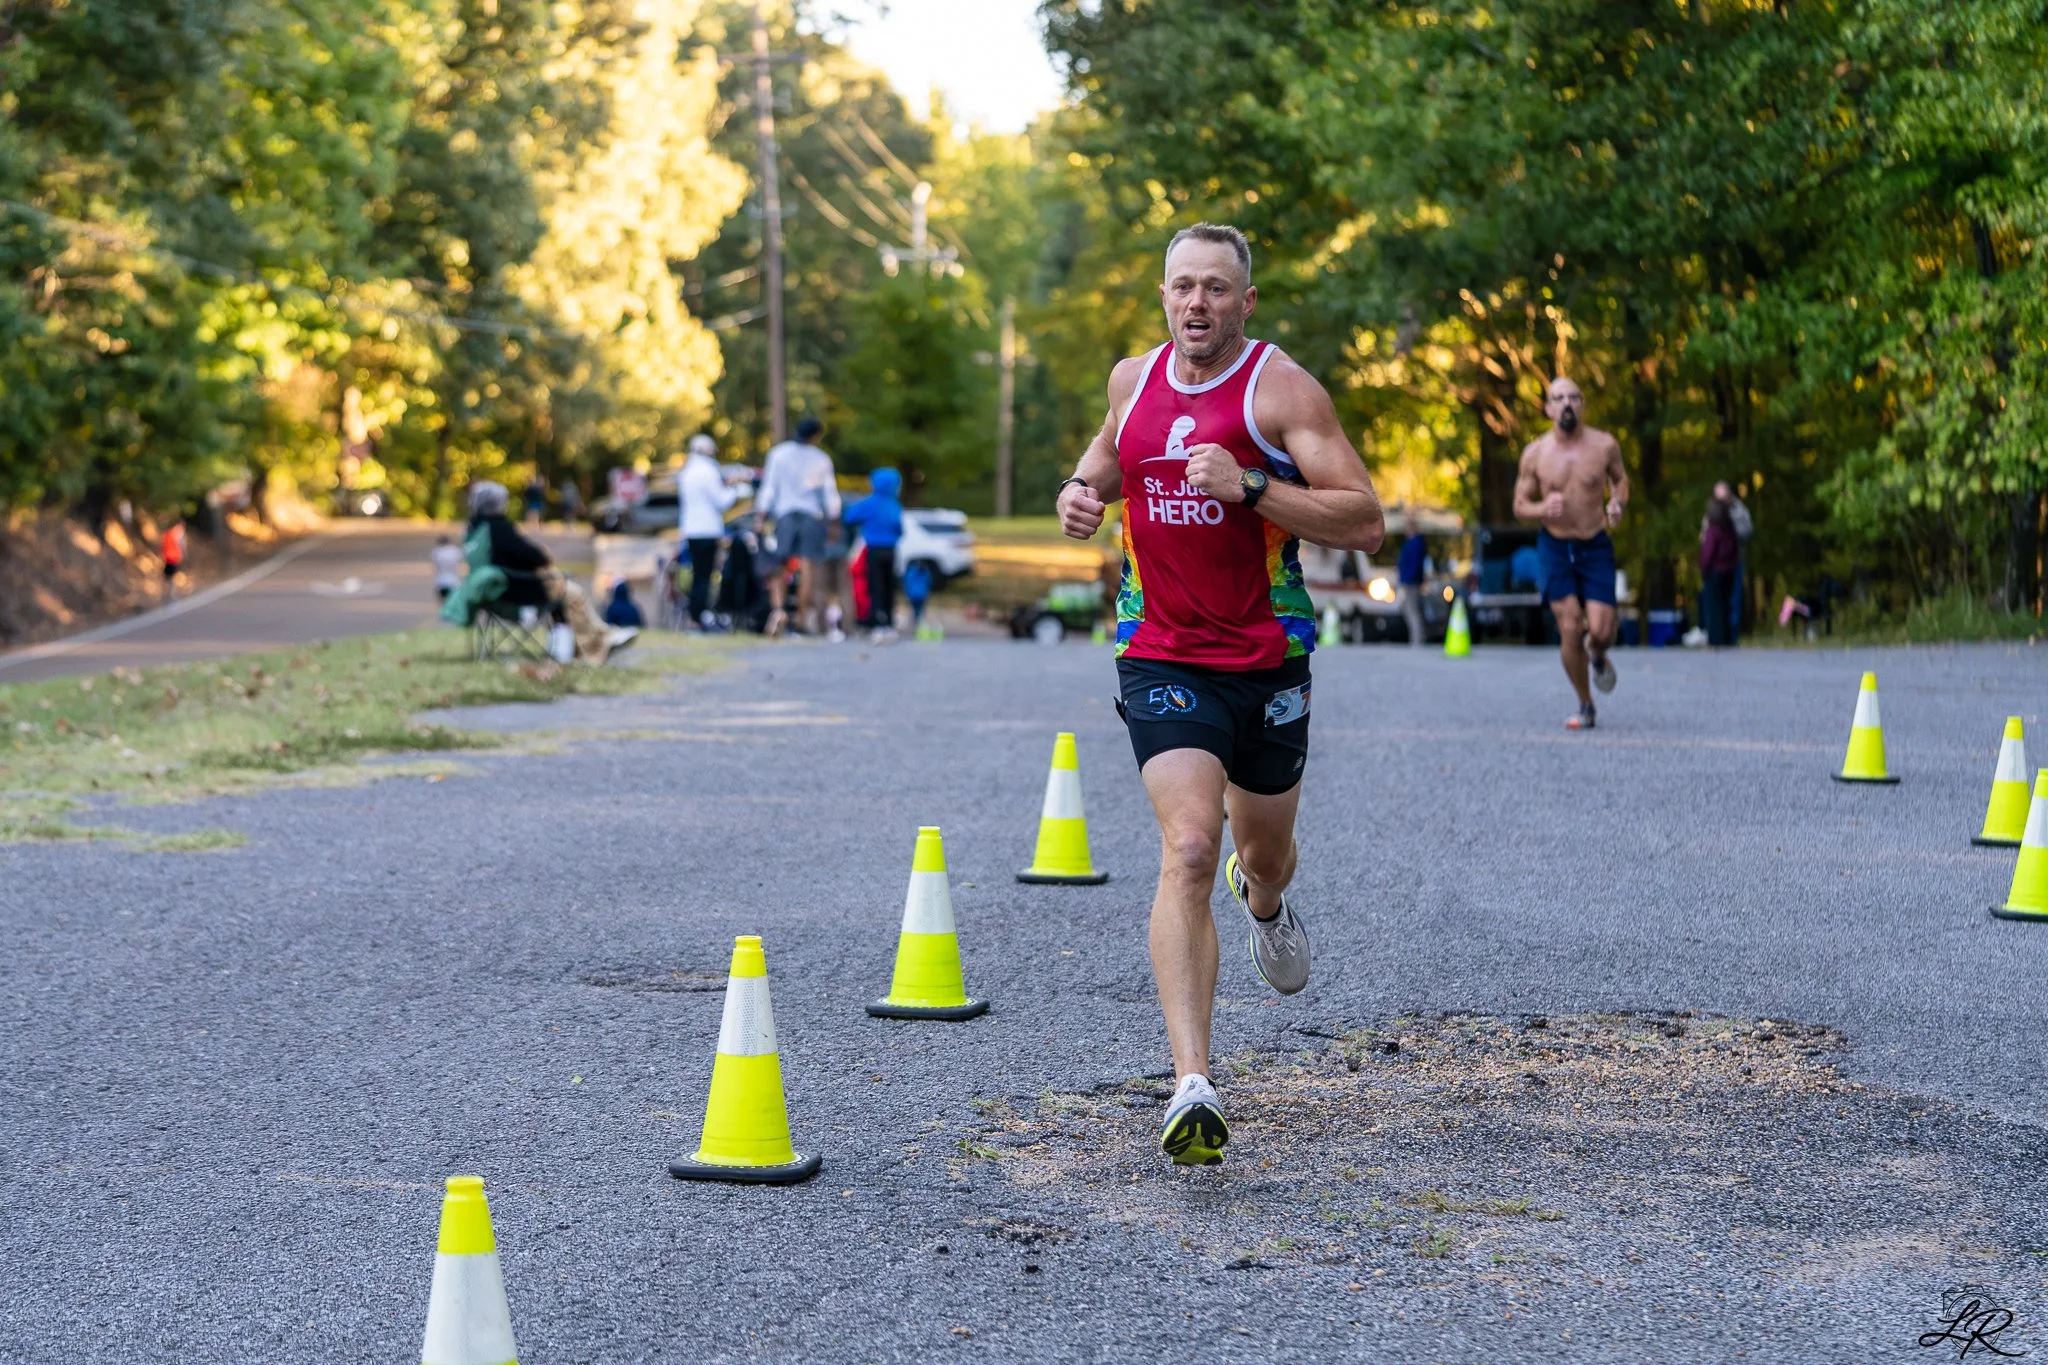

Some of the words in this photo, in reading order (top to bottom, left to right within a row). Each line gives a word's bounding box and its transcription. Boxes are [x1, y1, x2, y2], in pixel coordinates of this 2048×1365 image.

[1143, 476, 1170, 496] St.
[1173, 480, 1210, 497] Ju
[1147, 497, 1225, 526] HERO
